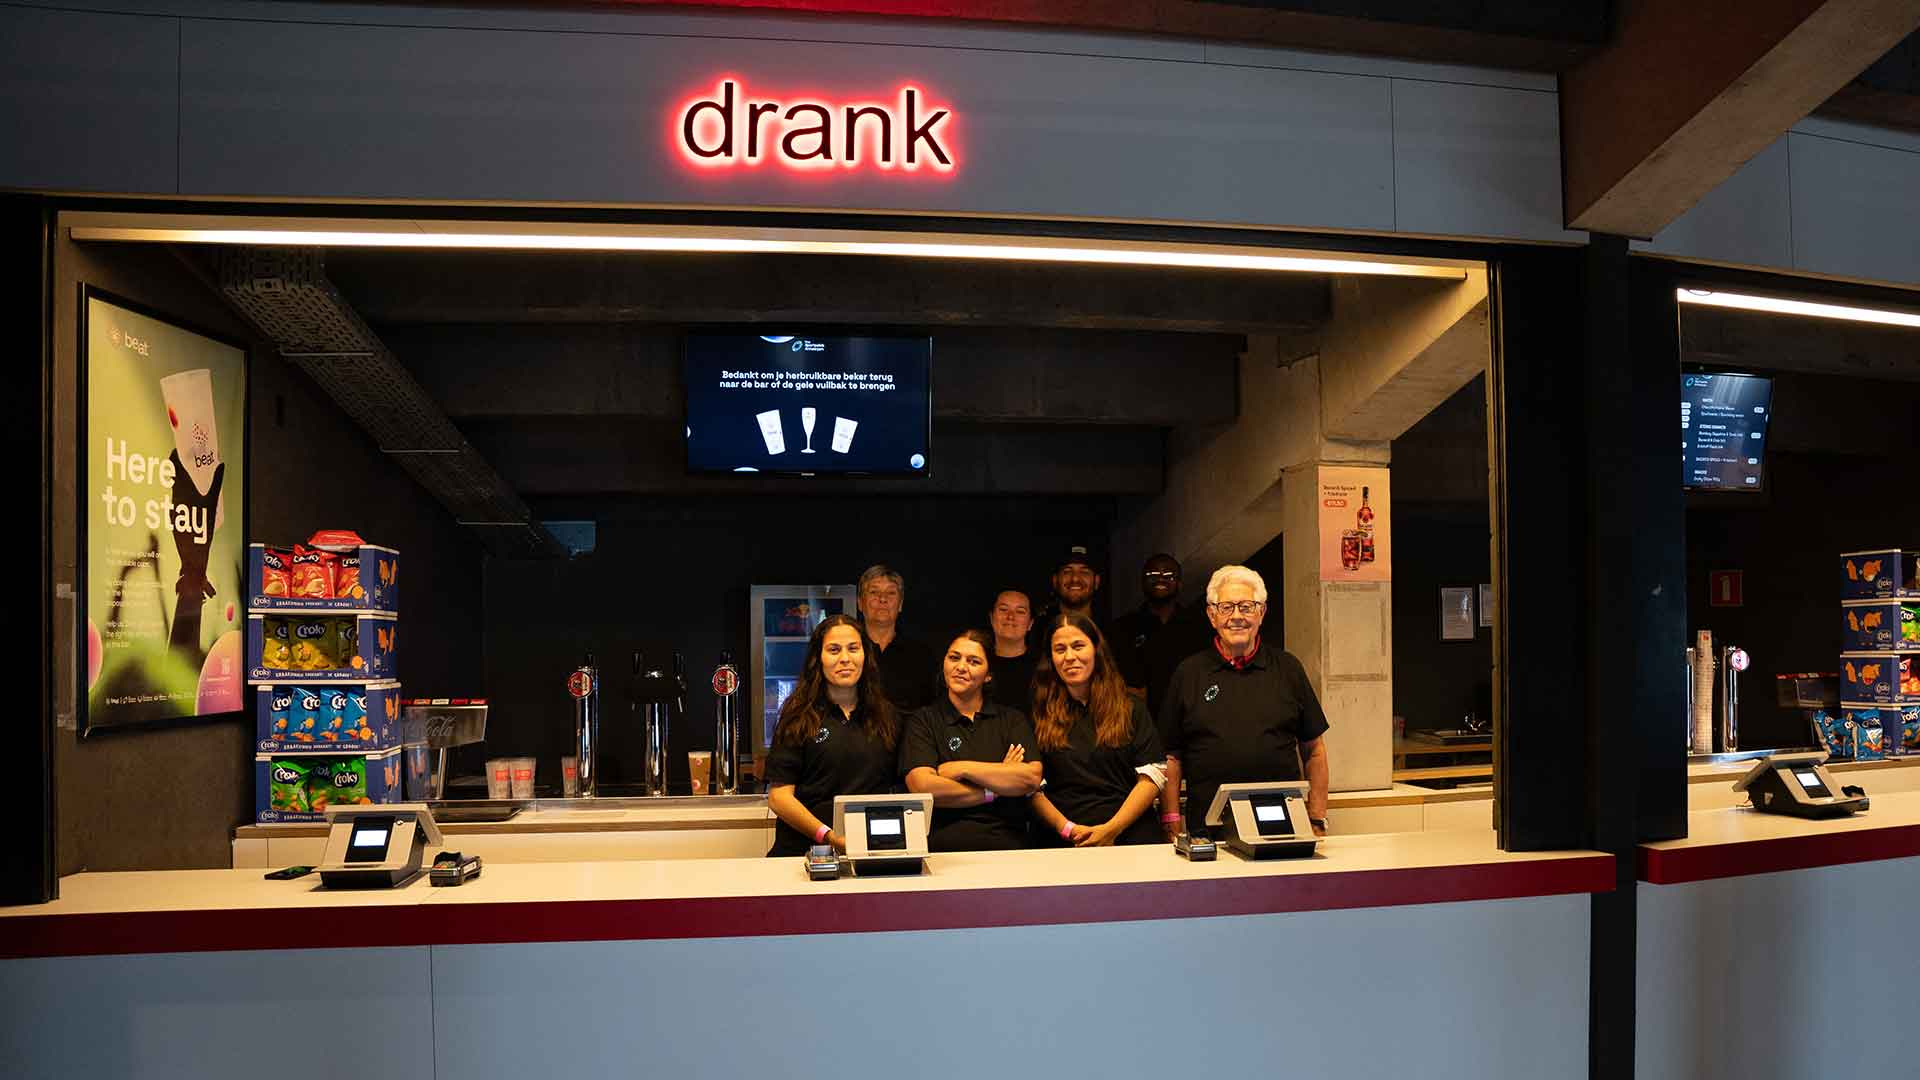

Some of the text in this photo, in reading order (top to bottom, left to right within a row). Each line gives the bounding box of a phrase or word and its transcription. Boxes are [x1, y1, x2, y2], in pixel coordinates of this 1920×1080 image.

[683, 81, 951, 165] drank
[722, 370, 759, 379] Bedankt
[775, 371, 784, 381] je
[785, 371, 841, 380] herbruikbare
[843, 372, 868, 380] beker
[869, 373, 893, 382] terug
[741, 380, 752, 388] de
[754, 380, 769, 388] bar
[770, 380, 781, 388] of
[782, 380, 794, 389] de
[795, 381, 814, 390] gele
[815, 381, 847, 389] vuilbak
[848, 382, 858, 390] te
[859, 381, 896, 392] brengen
[106, 437, 176, 489] Here
[194, 451, 215, 468] beat
[102, 485, 208, 545] to stay
[303, 696, 320, 710] Cro
[335, 773, 358, 787] Croky
